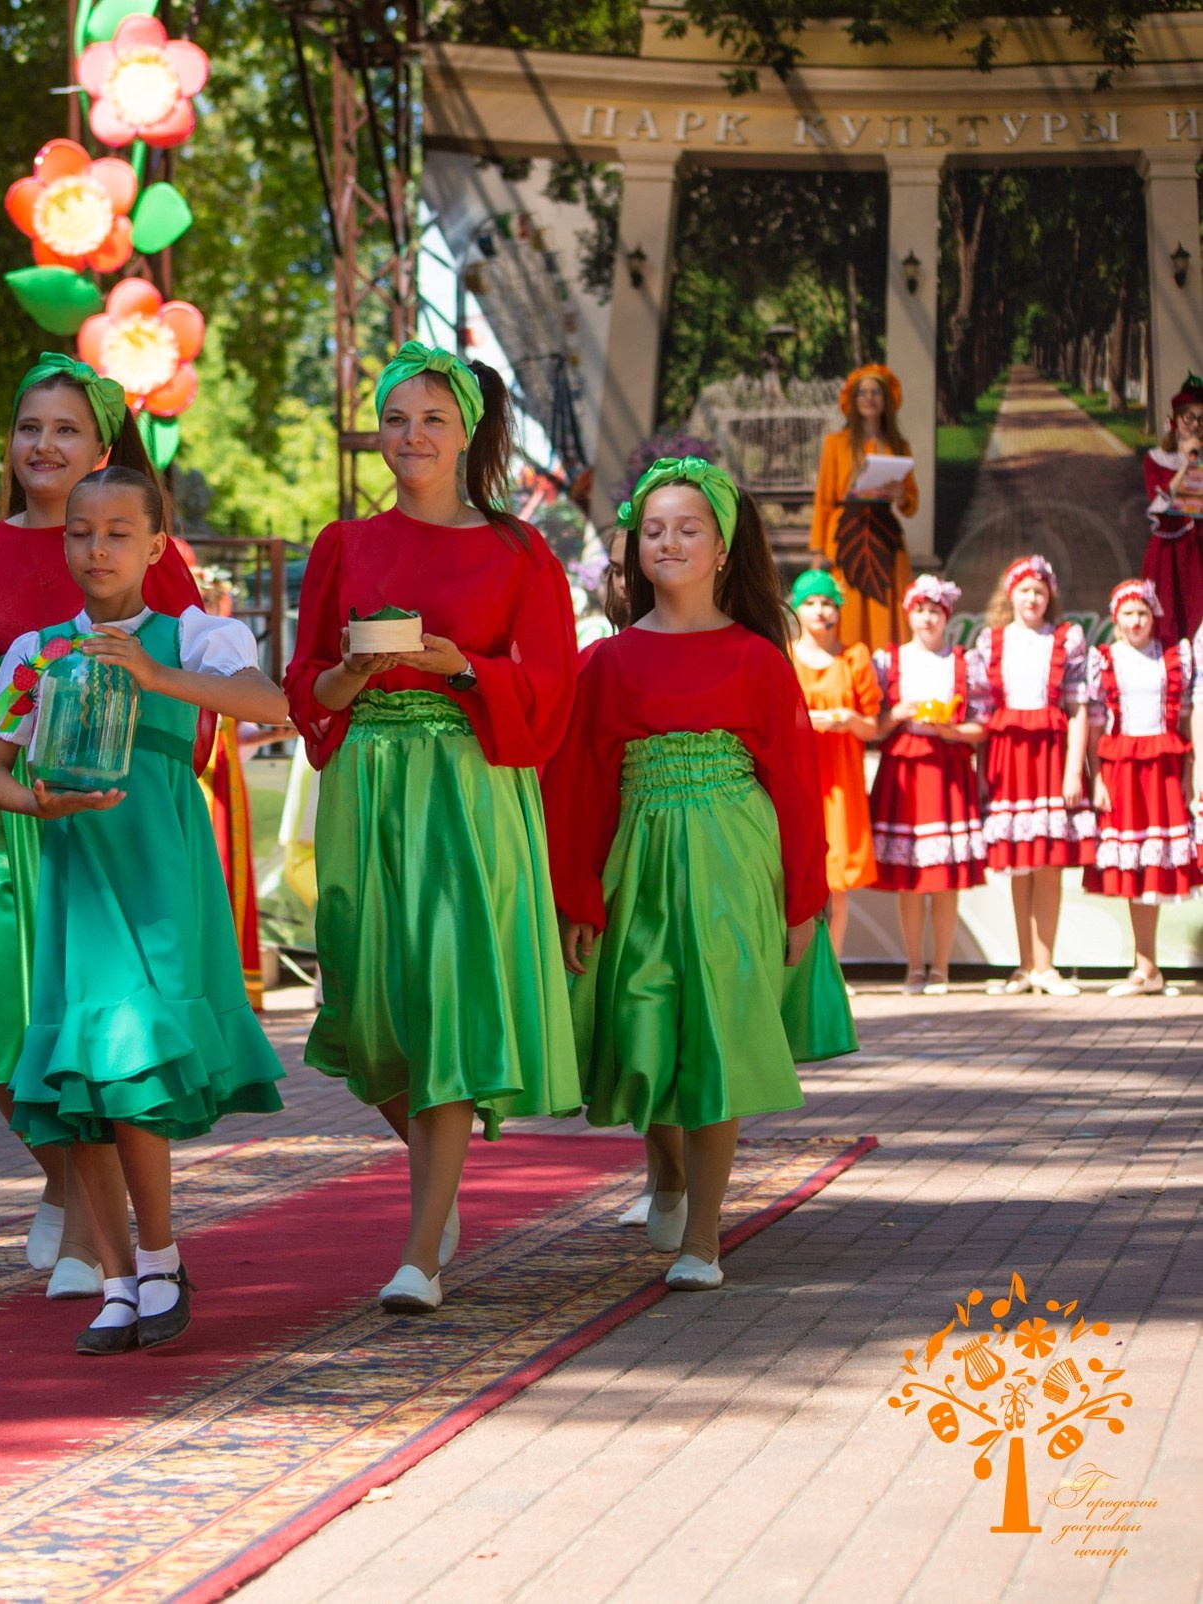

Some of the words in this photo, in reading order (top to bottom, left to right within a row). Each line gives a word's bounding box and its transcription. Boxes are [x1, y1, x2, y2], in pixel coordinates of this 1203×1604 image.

[579, 104, 749, 145] ПАРК
[793, 110, 1122, 147] КУЛЬТУРЫ
[1164, 109, 1202, 142] И
